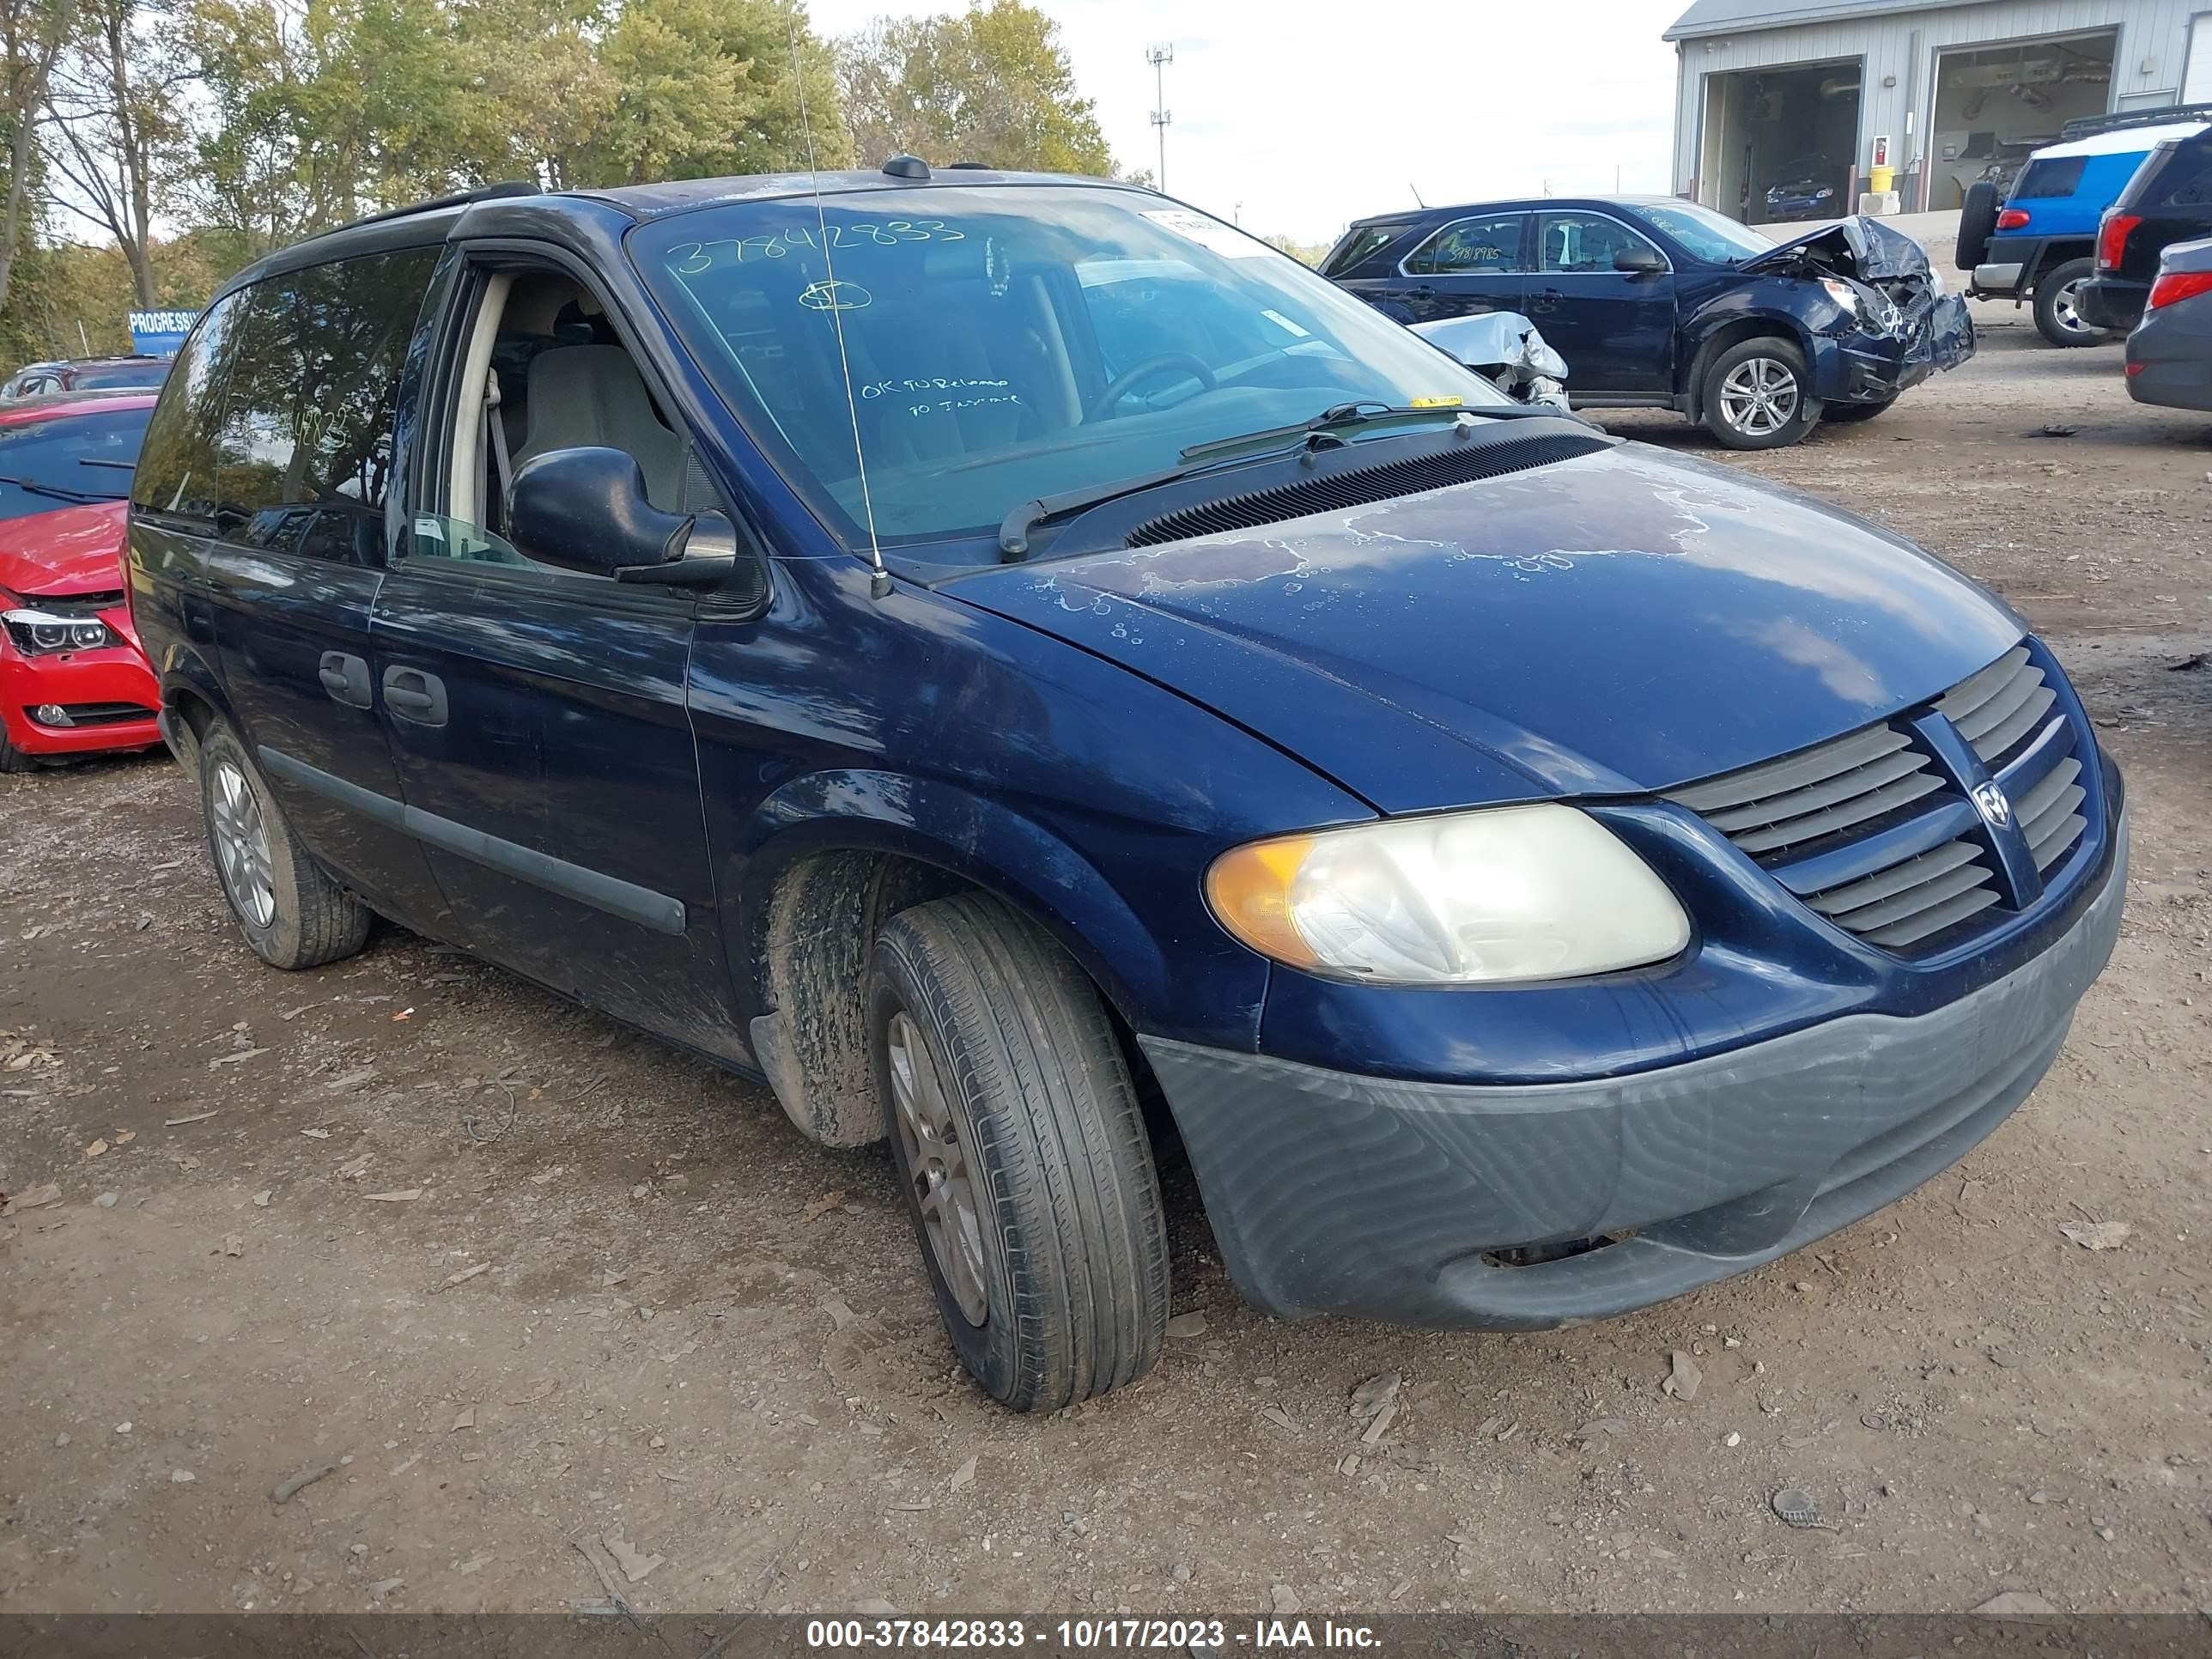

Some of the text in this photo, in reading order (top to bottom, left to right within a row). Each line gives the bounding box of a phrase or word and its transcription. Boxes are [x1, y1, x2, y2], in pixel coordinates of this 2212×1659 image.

[667, 222, 965, 273] 37842833
[129, 312, 199, 333] PROGRESSI
[862, 380, 902, 399] OK
